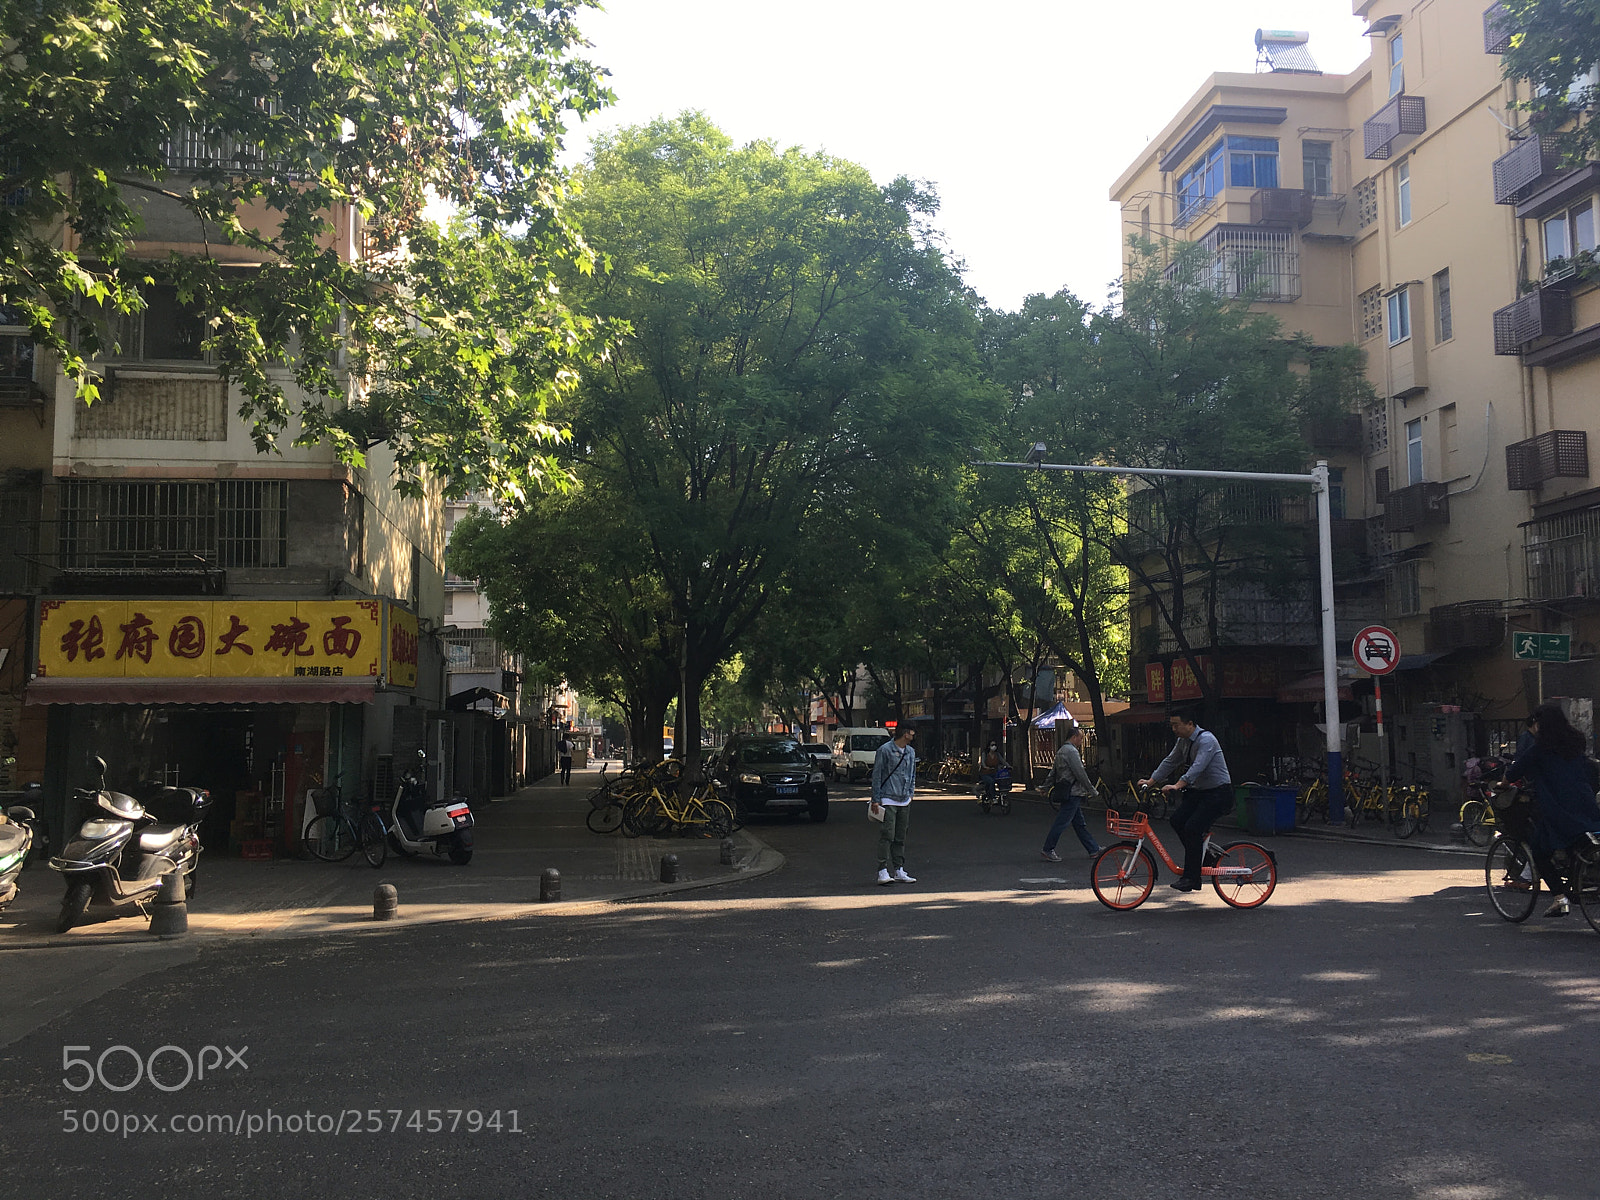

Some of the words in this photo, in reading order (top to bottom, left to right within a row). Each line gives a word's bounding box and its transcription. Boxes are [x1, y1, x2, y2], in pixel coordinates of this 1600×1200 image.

[61, 612, 362, 663] 张府园大碗面
[294, 666, 344, 677] 南湖路店
[1151, 663, 1198, 691] 胖砂锅
